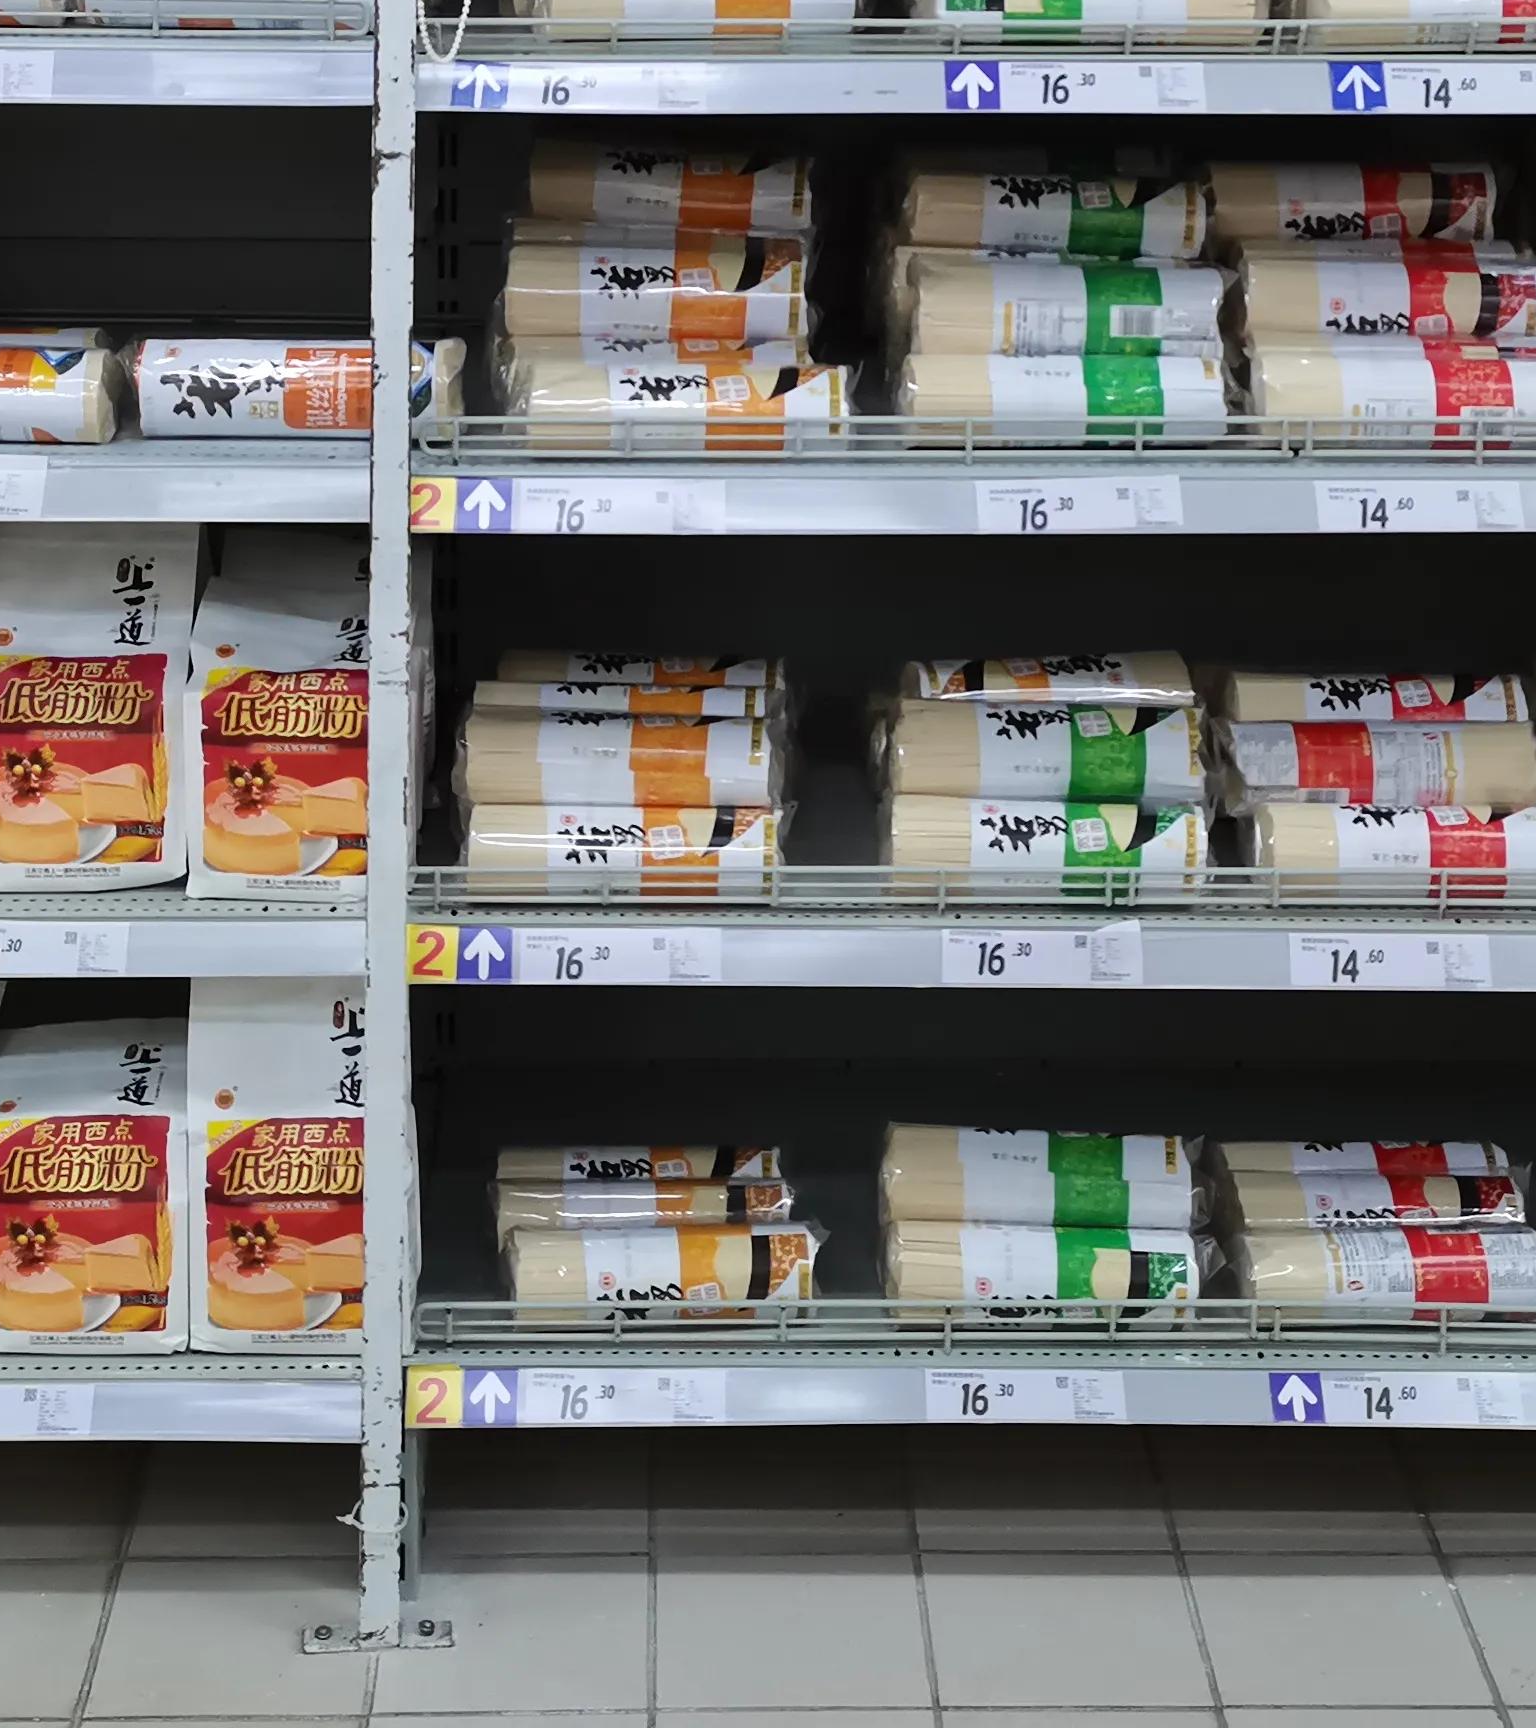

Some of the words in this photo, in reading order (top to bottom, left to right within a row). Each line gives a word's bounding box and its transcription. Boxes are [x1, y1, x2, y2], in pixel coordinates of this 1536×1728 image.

[411, 483, 443, 526] 2
[30, 660, 130, 680] 家用西点
[412, 931, 446, 976] 2
[32, 1121, 133, 1143] 家用西点
[0, 1145, 157, 1194] 低筋粉
[416, 1378, 448, 1423] 2
